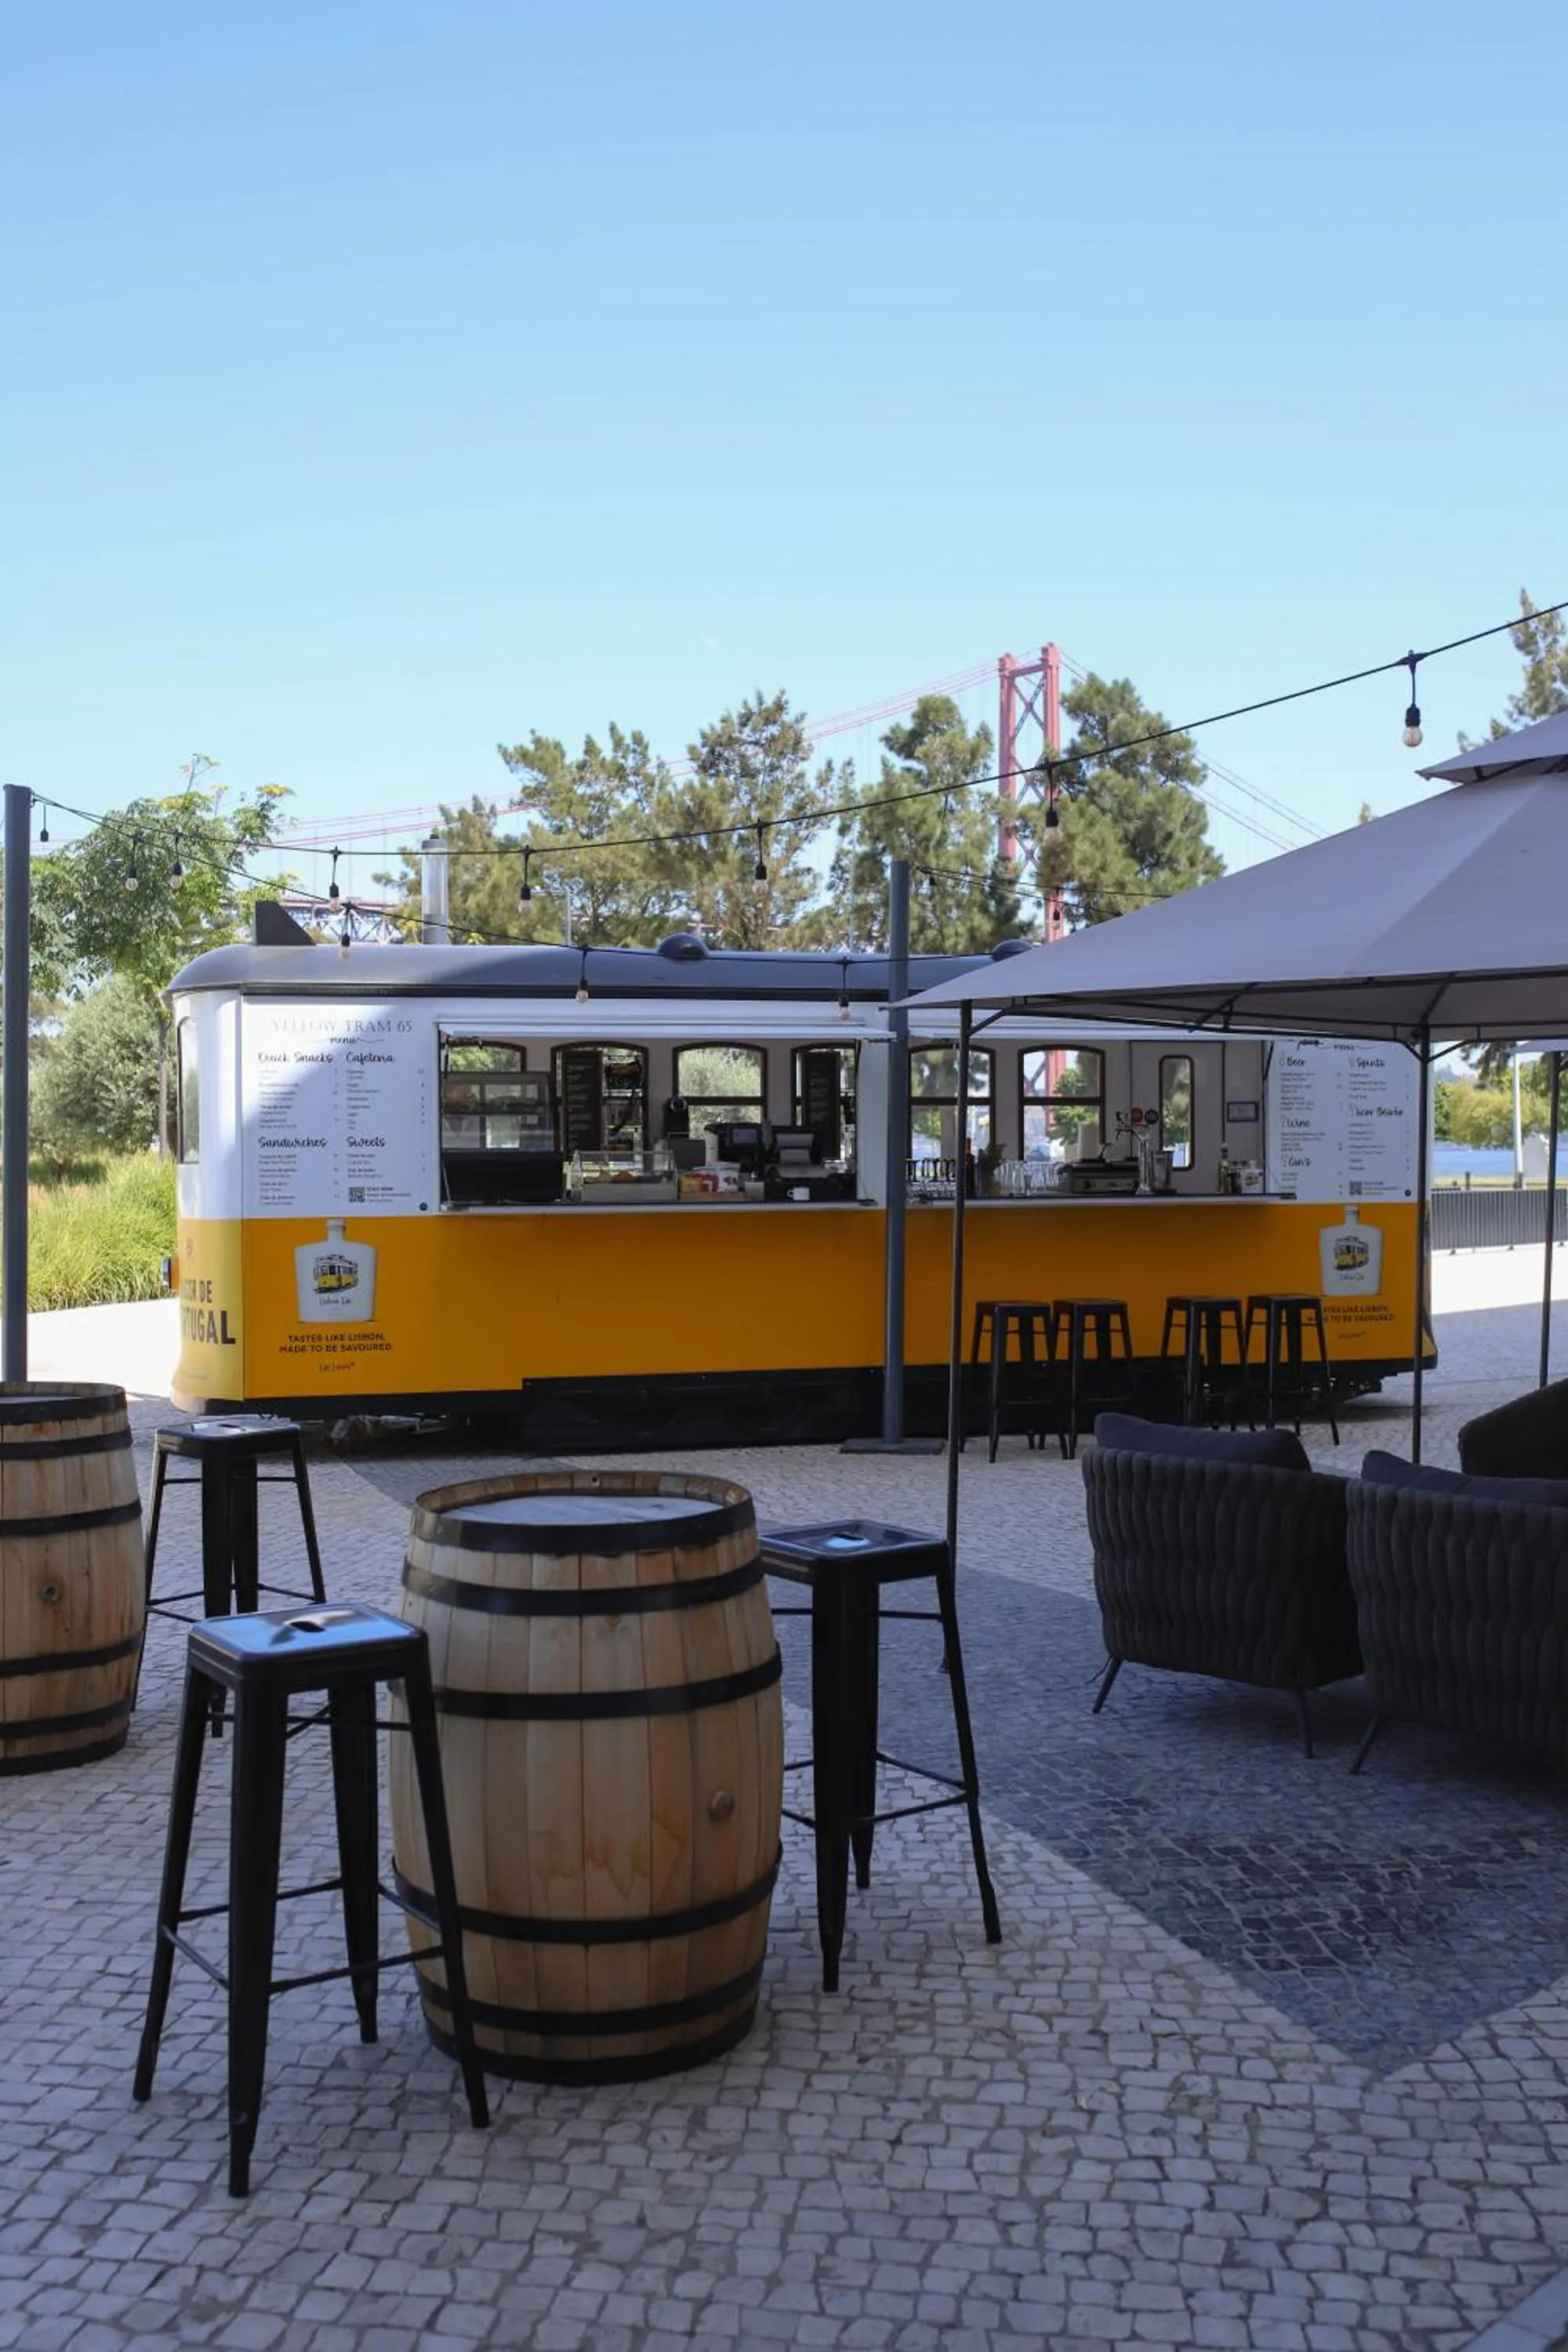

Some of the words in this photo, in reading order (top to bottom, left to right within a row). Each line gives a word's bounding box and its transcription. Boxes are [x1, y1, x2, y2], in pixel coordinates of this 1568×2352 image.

[270, 1018, 336, 1033] YELLOW
[346, 1020, 391, 1033] TRAM
[397, 1020, 412, 1033] 65
[258, 1135, 328, 1149] Sandwiches
[346, 1136, 387, 1148] Sweets
[199, 1279, 212, 1304] DE
[289, 1334, 322, 1343] TASTES
[325, 1334, 346, 1342] LIKE
[278, 1345, 307, 1353] MADE
[309, 1345, 324, 1353] TO
